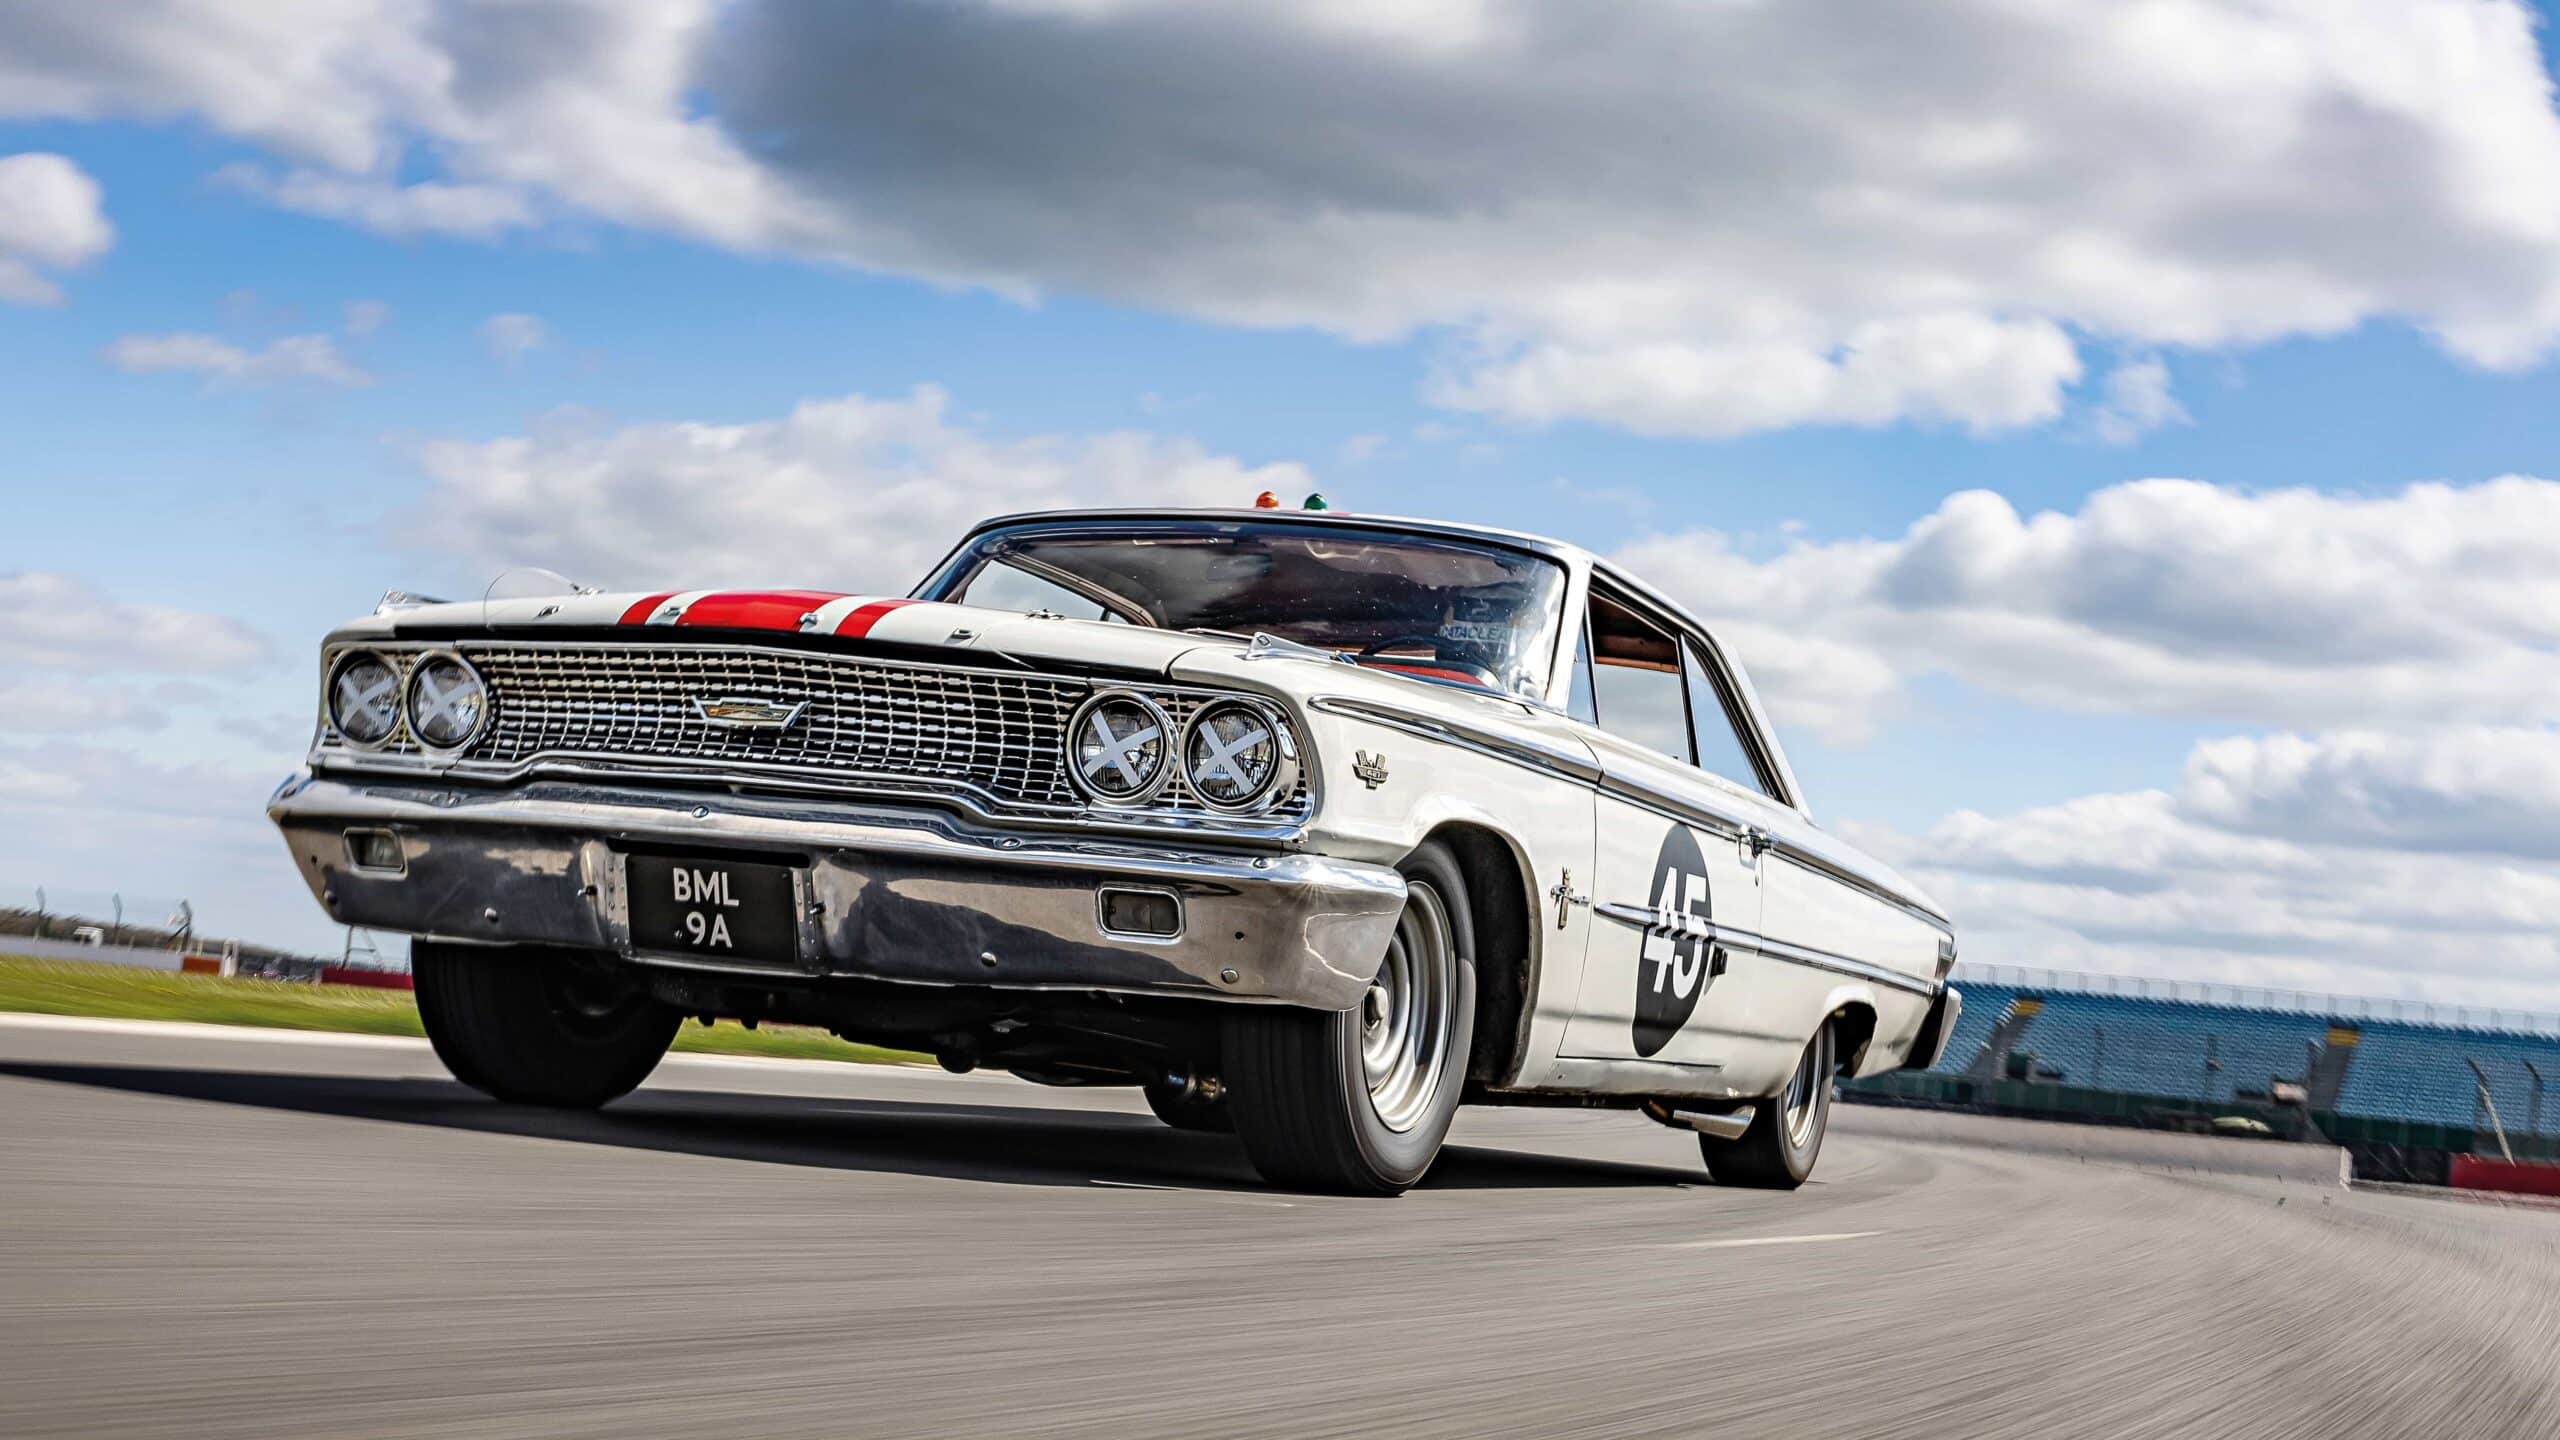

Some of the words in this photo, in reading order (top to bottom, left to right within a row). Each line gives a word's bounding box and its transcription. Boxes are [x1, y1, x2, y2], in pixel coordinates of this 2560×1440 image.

[672, 867, 740, 907] BML
[686, 911, 733, 949] 9A
[1643, 866, 1709, 1000] 45
